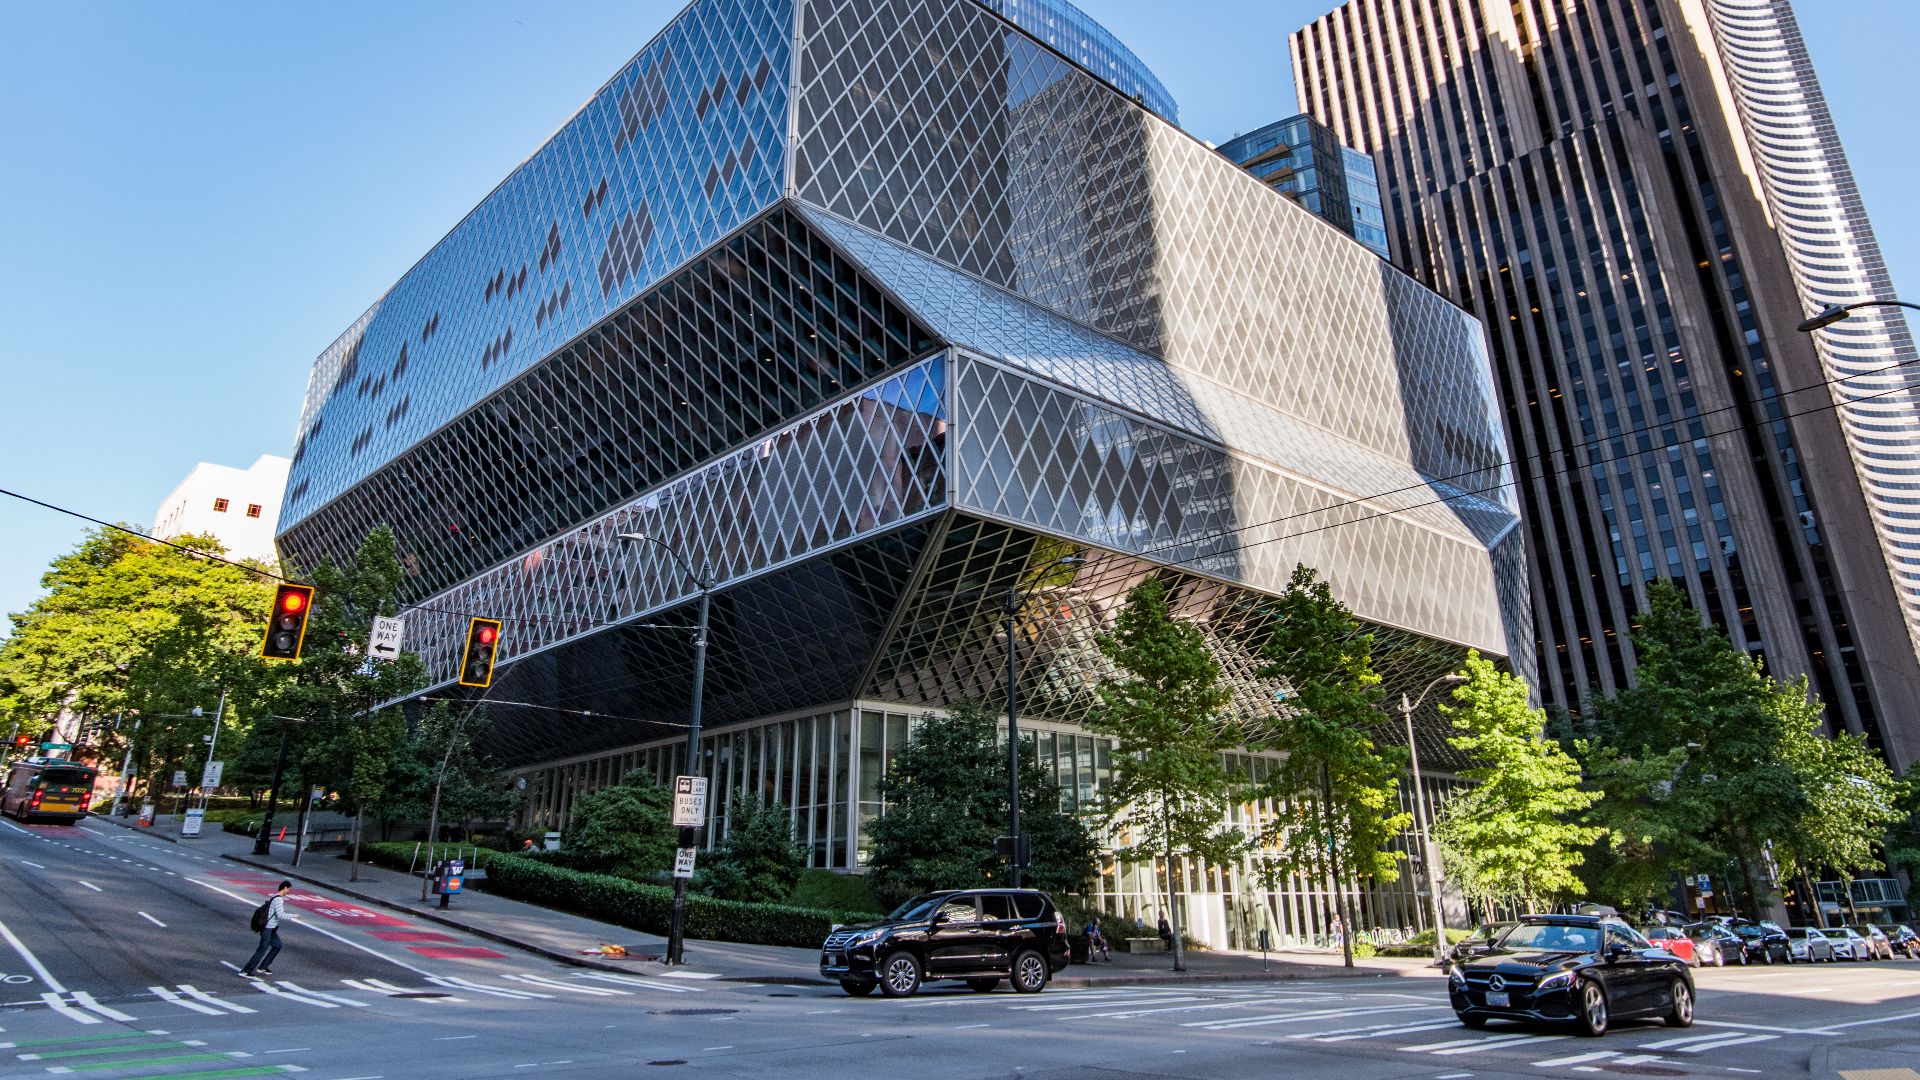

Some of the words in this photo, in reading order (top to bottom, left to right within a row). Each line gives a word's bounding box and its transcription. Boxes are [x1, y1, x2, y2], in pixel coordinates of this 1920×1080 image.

[379, 620, 398, 631] ONE
[377, 631, 397, 641] WAY
[679, 797, 702, 806] BUSES
[681, 806, 699, 815] ONLY
[679, 850, 694, 859] ONE
[315, 908, 377, 918] BUS
